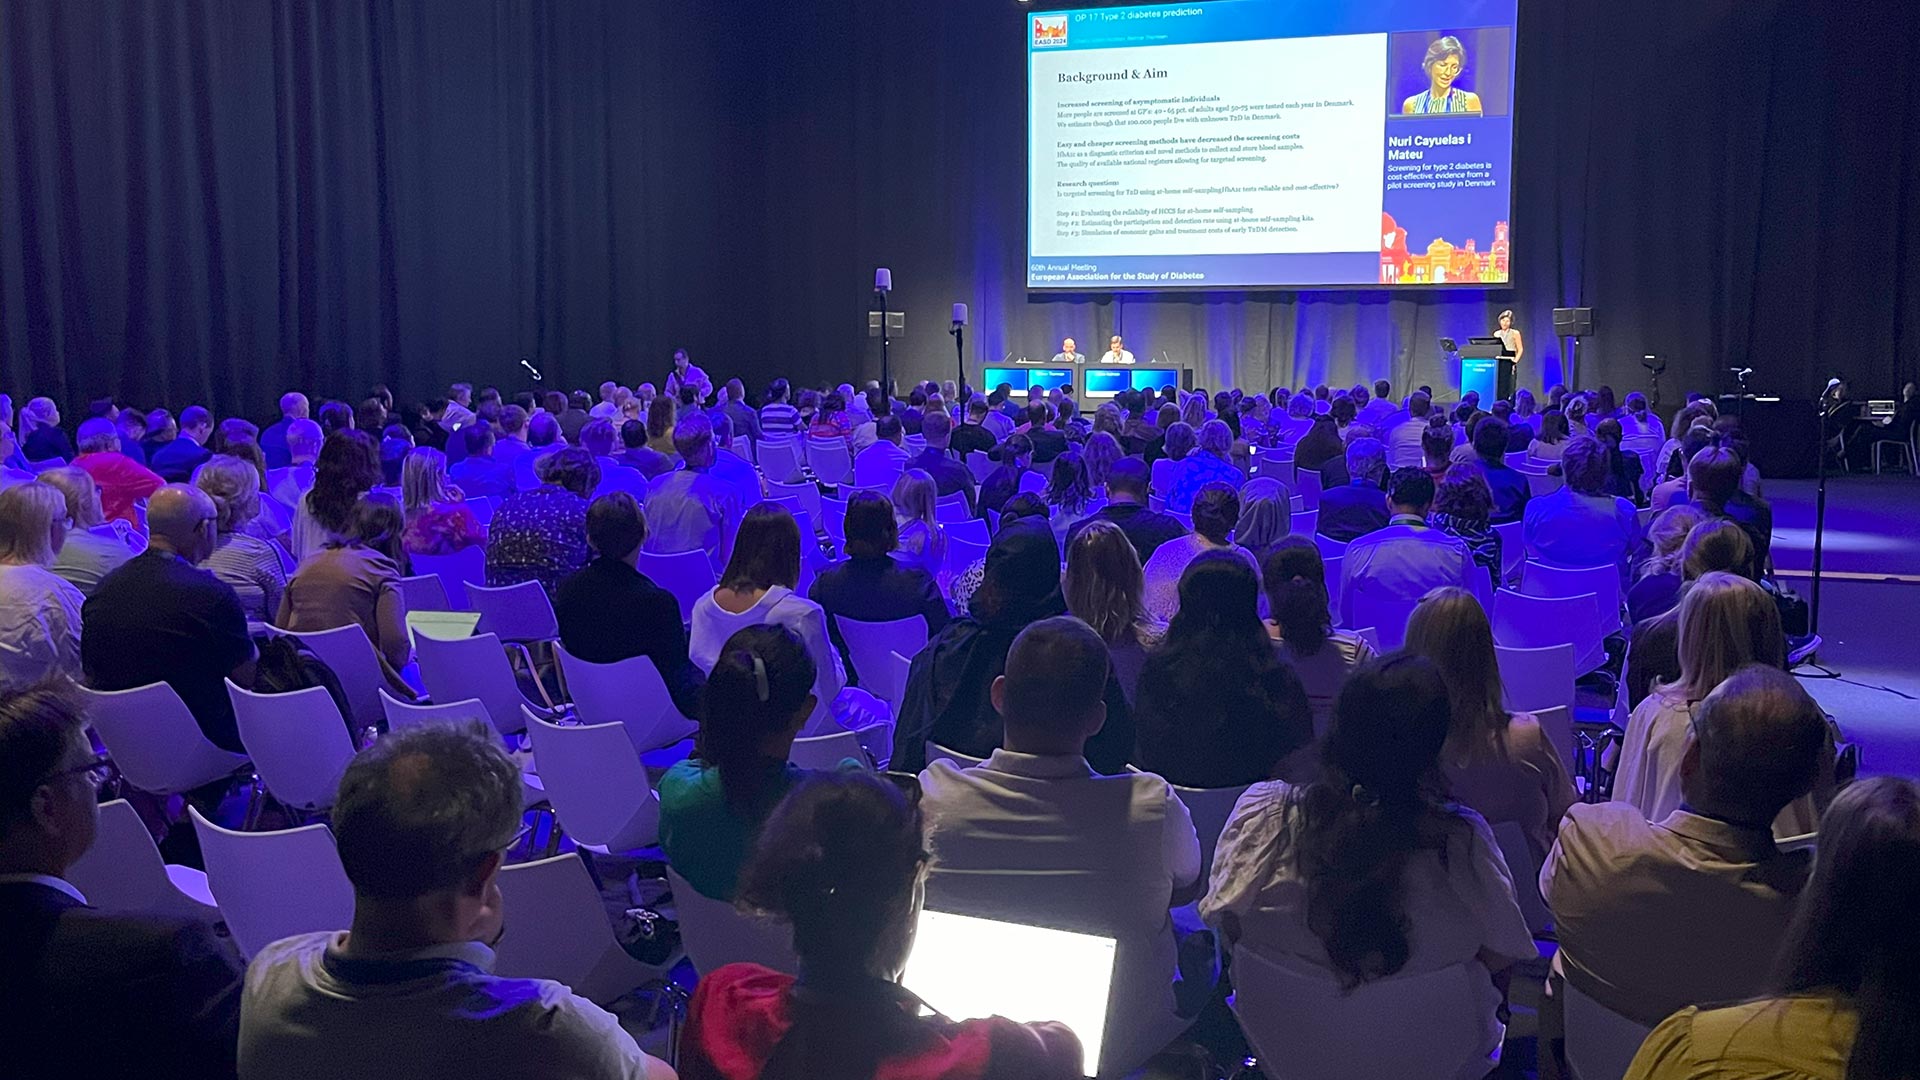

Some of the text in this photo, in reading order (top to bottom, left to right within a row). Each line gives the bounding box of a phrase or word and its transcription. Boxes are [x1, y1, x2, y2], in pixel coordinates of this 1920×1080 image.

[1100, 12, 1118, 22] Type
[1128, 11, 1161, 19] diabetes
[1163, 8, 1202, 17] prediction
[1058, 68, 1168, 83] Background & Aim
[1133, 97, 1180, 106] asymptomatic
[1182, 95, 1220, 103] individuals
[1087, 140, 1114, 148] cheaper
[1247, 134, 1280, 142] screening
[1389, 134, 1464, 148] Nuri Cayuelas
[1388, 150, 1423, 160] Mateu
[1137, 272, 1159, 281] Study
